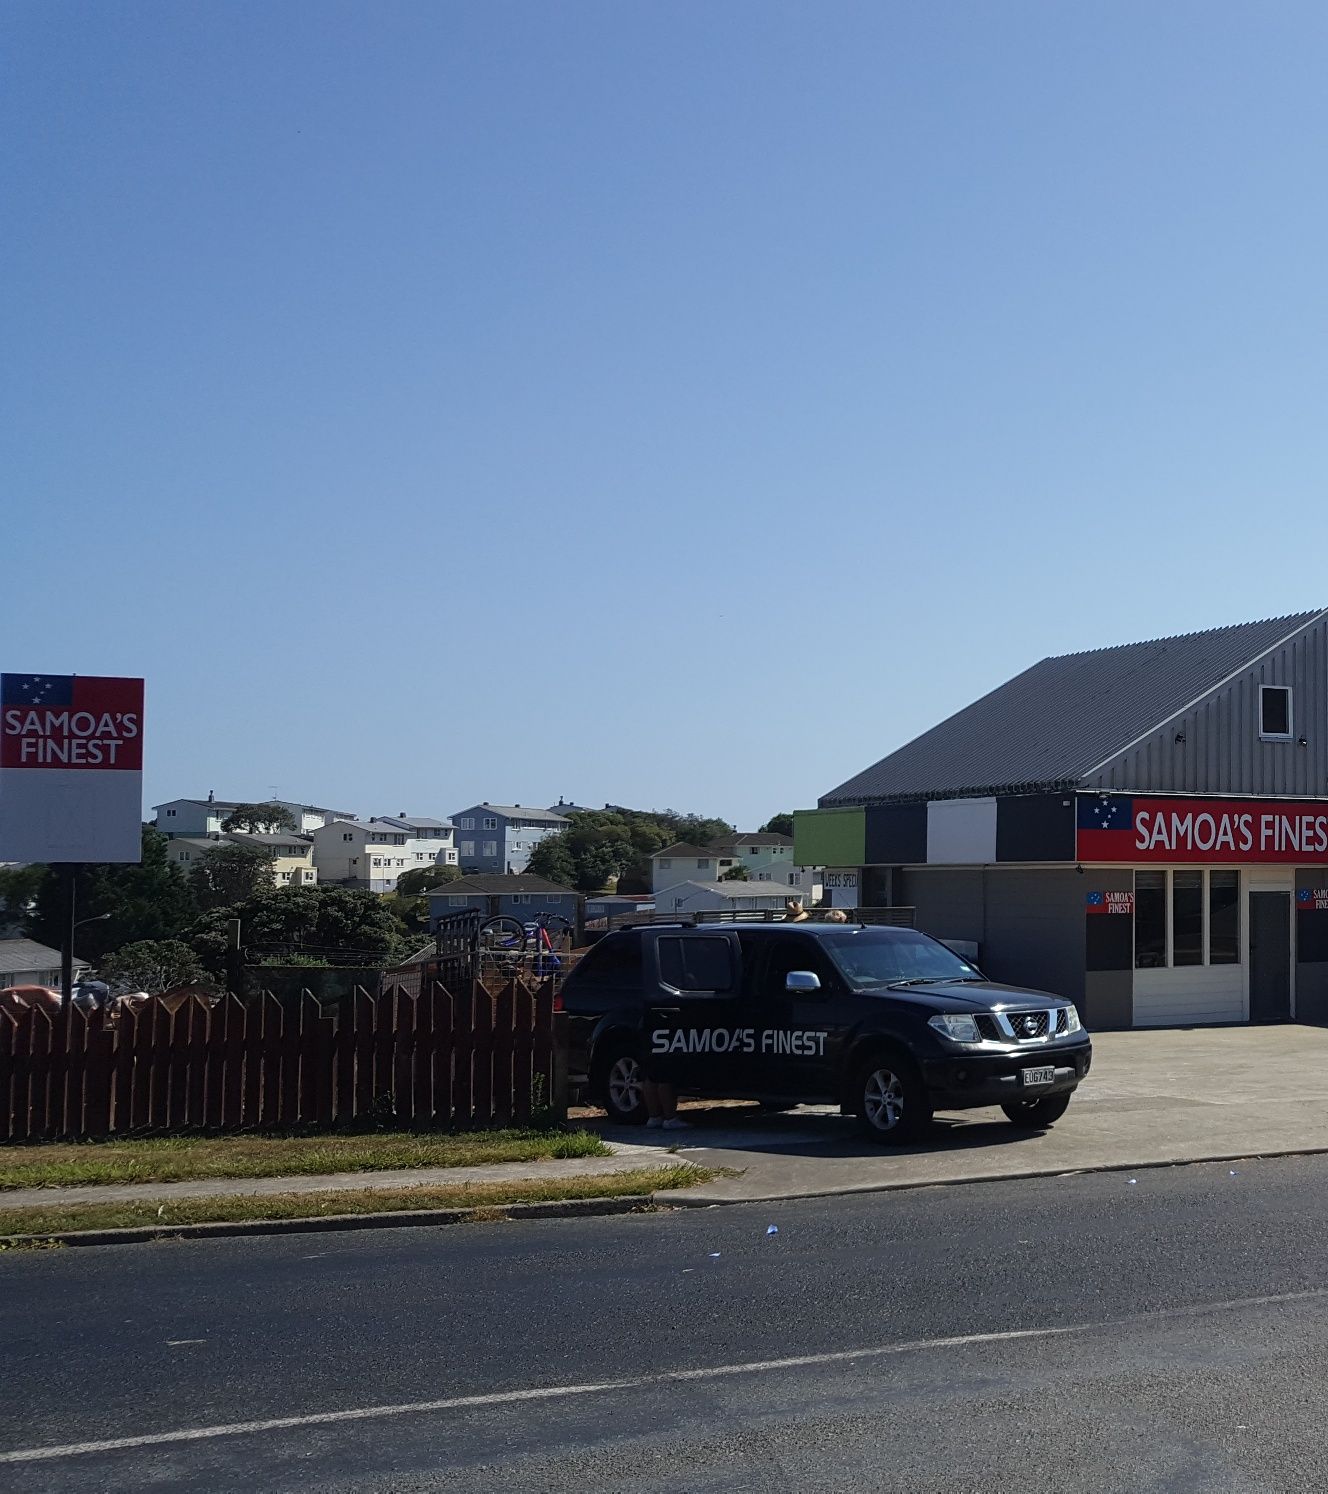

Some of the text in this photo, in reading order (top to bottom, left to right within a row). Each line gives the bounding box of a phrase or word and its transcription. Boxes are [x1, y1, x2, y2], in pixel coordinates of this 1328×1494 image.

[5, 710, 138, 738] SAMOA'S
[20, 738, 123, 764] FINEST
[1136, 811, 1253, 851] SAMOA'S
[1105, 891, 1134, 903] SAMOA'S
[1108, 902, 1131, 914] FINEST
[652, 1028, 828, 1056] SAMOA'S FINEST
